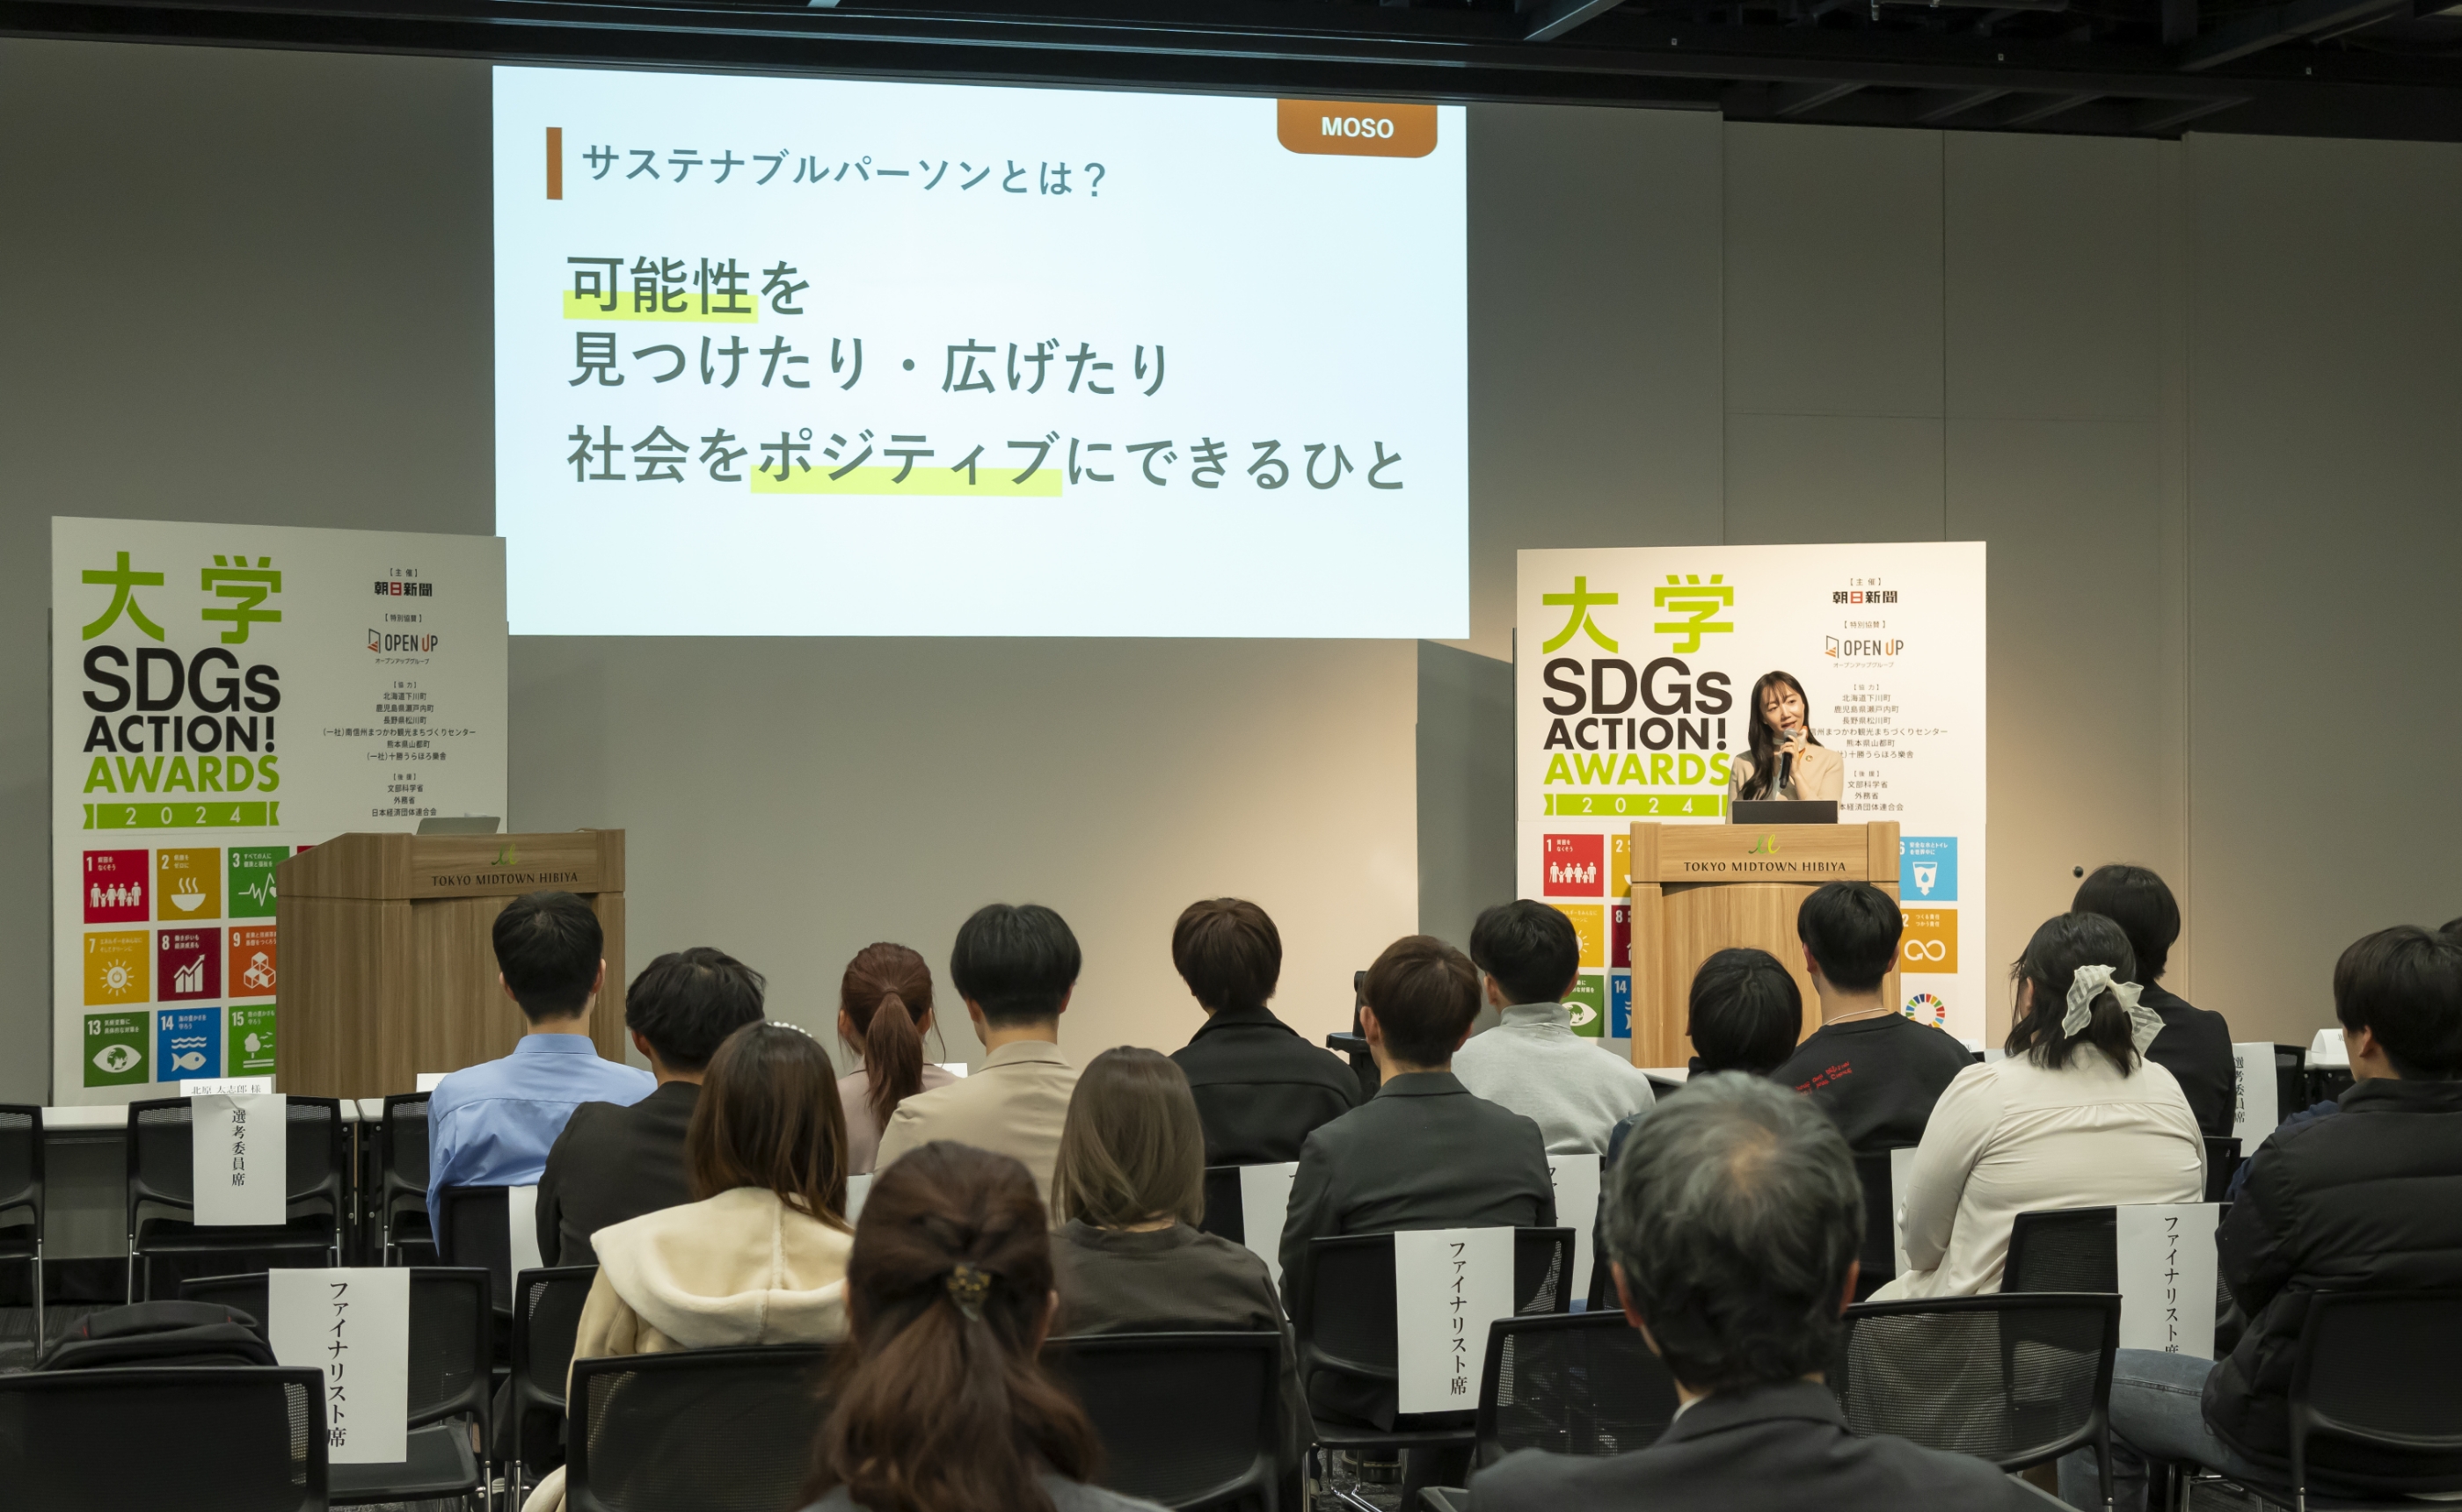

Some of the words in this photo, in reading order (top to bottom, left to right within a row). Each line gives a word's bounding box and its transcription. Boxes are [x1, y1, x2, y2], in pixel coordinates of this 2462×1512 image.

[1322, 116, 1395, 139] MOSO
[582, 143, 1108, 198] サステナブルパーソンとは？
[566, 255, 811, 316] 可能性を
[568, 331, 1168, 397] 見つけたり・広げたり
[567, 424, 1406, 491] 社会をポジティブにできるひと
[374, 581, 433, 597] 朝日新聞
[82, 551, 281, 644] 大学
[1832, 591, 1898, 604] 朝日新聞
[1541, 574, 1735, 654] 大学
[384, 634, 419, 652] OPEN
[421, 633, 438, 652] UP
[1844, 640, 1882, 656] OPEN
[1885, 638, 1905, 656] UP
[83, 644, 281, 714] SDGs
[1542, 657, 1733, 716] SDGs
[1842, 694, 1891, 702] 北海道下川町
[375, 704, 434, 713] 鹿児島県瀬戸内町
[1834, 705, 1899, 714] 鹿児島県瀬戸内町
[383, 716, 426, 725] 長野県松川町
[83, 714, 275, 753] ACTION!
[1543, 716, 1727, 751] ACTION!
[387, 740, 431, 749] 熊本県山都町
[83, 753, 280, 794] AWARDS
[1543, 752, 1731, 787] AWARDS
[387, 784, 424, 793] 文部科学省
[393, 796, 415, 805] 外務省
[1582, 796, 1694, 814] 2024
[125, 805, 242, 825] 2024
[372, 808, 437, 817] 日本経済団体連合会
[1547, 839, 1552, 852] 1
[1615, 840, 1623, 853] 2
[86, 856, 93, 872] 1
[161, 854, 170, 869] 2
[232, 853, 240, 868] 3
[1684, 861, 1726, 871] TOKYO
[1732, 861, 1797, 871] MIDTOWN
[1803, 861, 1846, 871] HIBIYA
[432, 875, 471, 887] TOKYO
[476, 873, 535, 885] MIDTOWN
[539, 872, 578, 883] HIBIYA
[1616, 910, 1623, 923] 8
[89, 938, 96, 954] 7
[162, 935, 170, 950] 8
[233, 932, 240, 947] 9
[1614, 980, 1627, 993] 14
[161, 1015, 174, 1031] 14
[231, 1012, 244, 1026] 15
[88, 1020, 101, 1036] 13
[231, 1109, 246, 1187] 選考委員席
[1450, 1242, 1468, 1396] ファイナリスト席
[327, 1282, 349, 1448] ファイナリスト席
